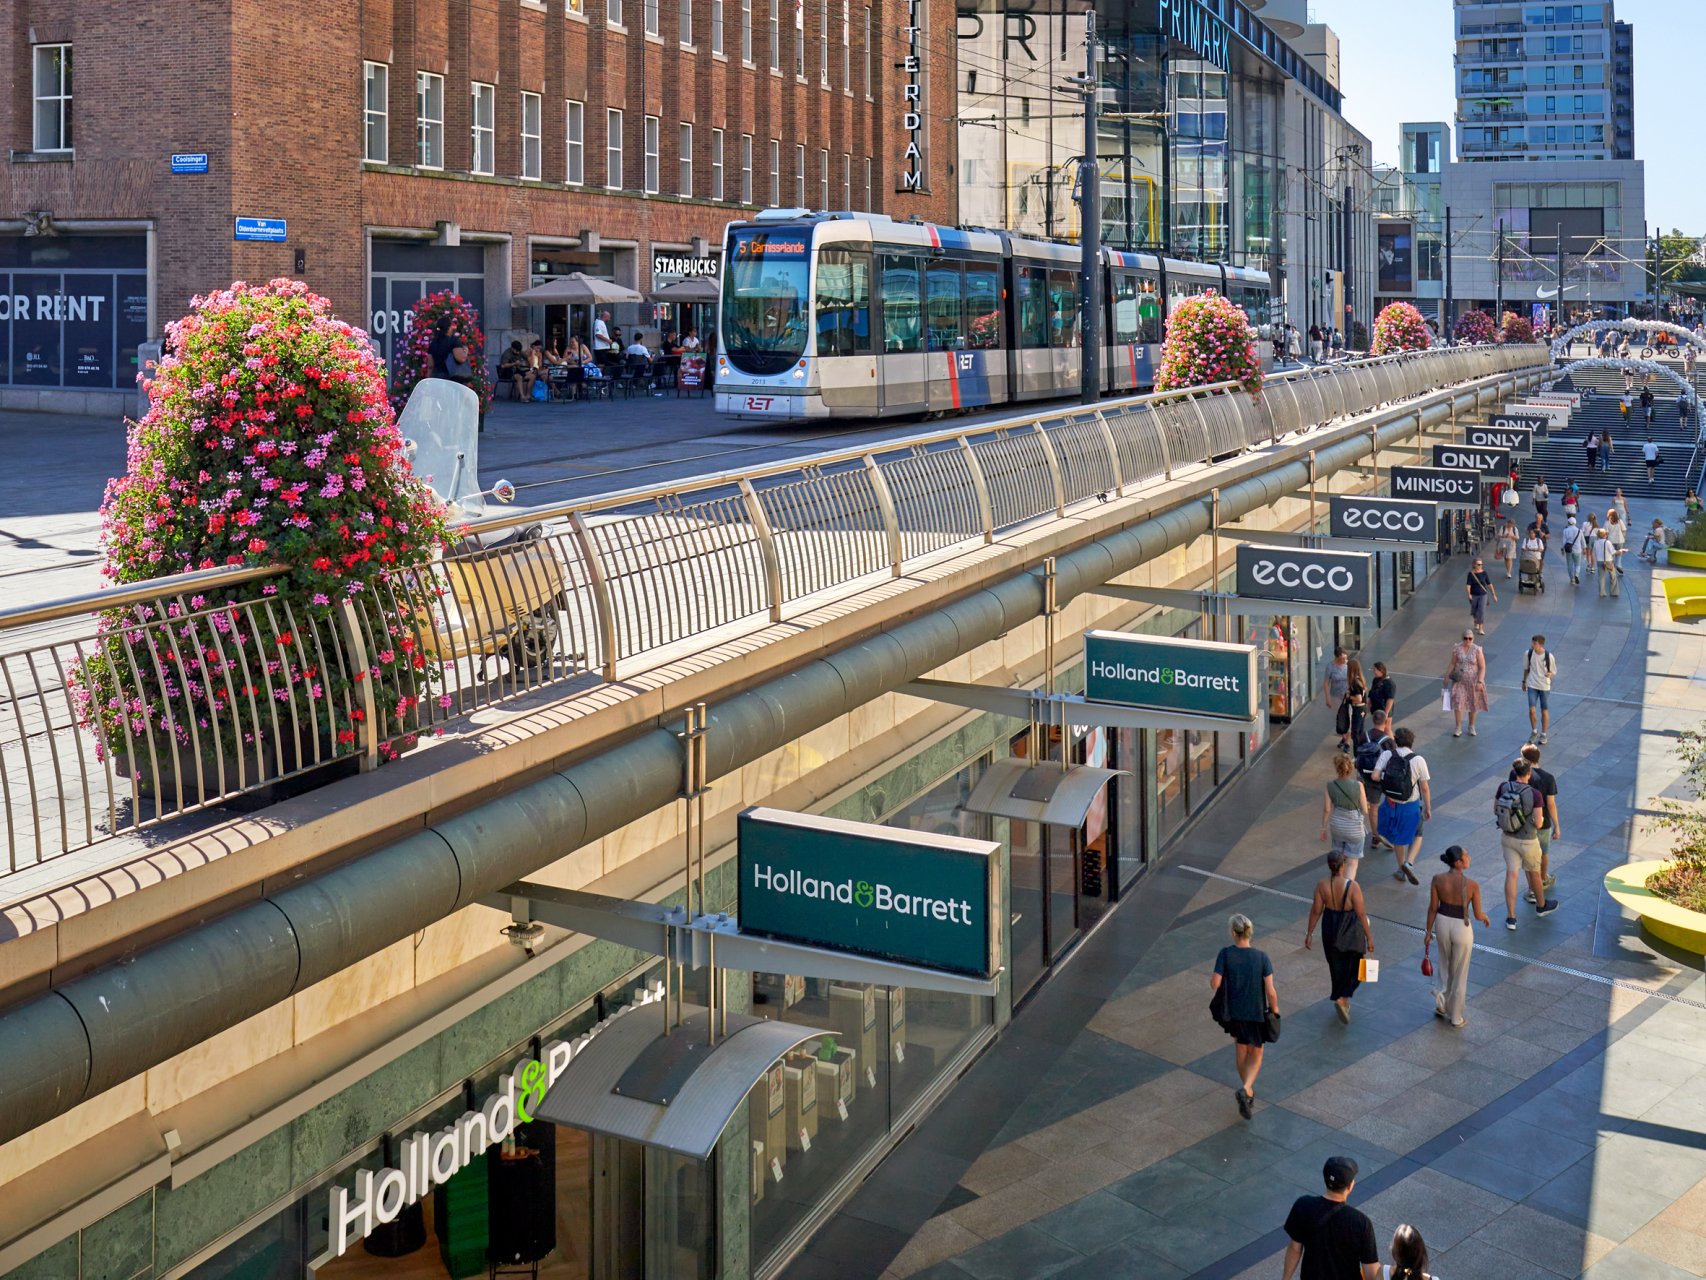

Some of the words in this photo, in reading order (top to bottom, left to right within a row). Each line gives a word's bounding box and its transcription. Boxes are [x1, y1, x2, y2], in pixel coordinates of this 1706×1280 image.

[739, 240, 747, 253] 5
[655, 258, 717, 274] STARBUCKS
[0, 295, 30, 320] OR
[37, 295, 105, 321] RENT
[371, 310, 400, 334] OR
[1495, 420, 1540, 432] ONLY
[1472, 432, 1523, 447] ONLY
[1441, 452, 1500, 469] ONLY
[1396, 476, 1457, 494] MINISO
[1343, 508, 1424, 532] ecco
[1252, 560, 1353, 591] ecco
